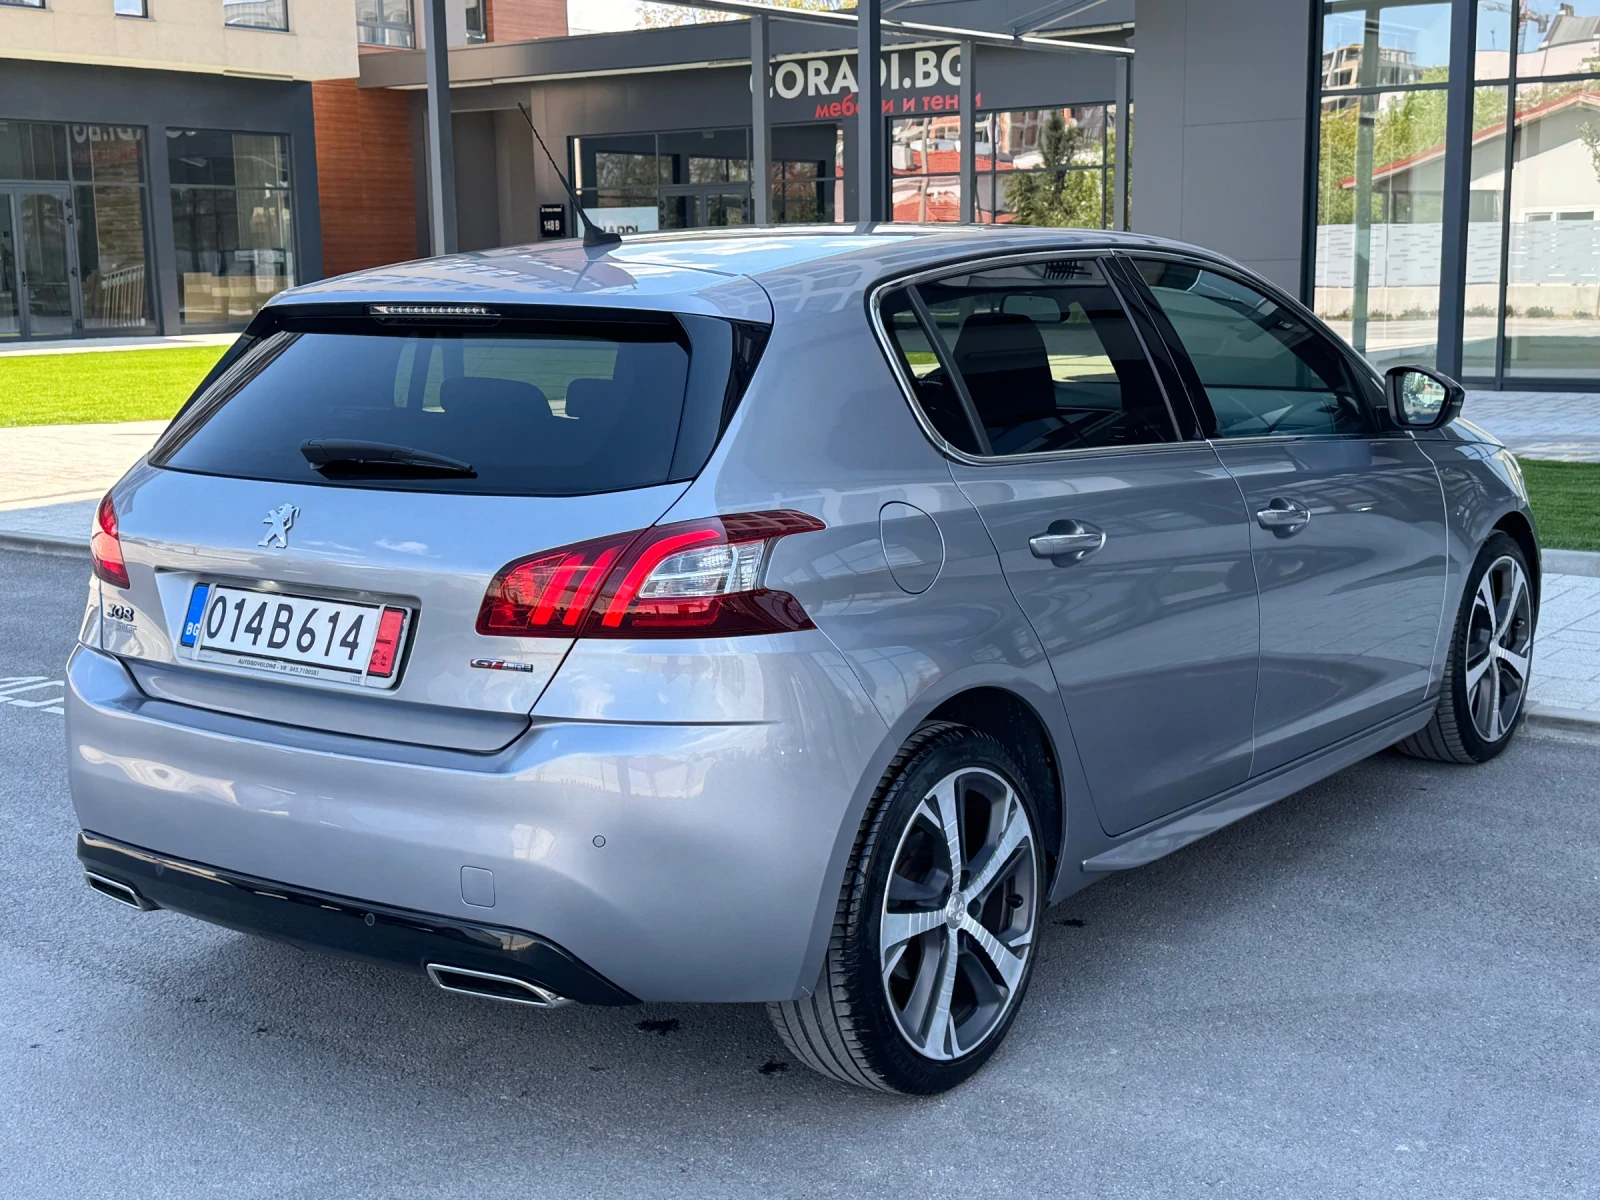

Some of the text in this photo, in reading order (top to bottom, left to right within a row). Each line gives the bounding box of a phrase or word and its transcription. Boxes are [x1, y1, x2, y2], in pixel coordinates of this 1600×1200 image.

[749, 49, 961, 100] ORAI.BG
[814, 92, 982, 119] меби и тени
[107, 603, 135, 622] 308
[185, 621, 201, 637] BG
[205, 595, 365, 661] 014B614
